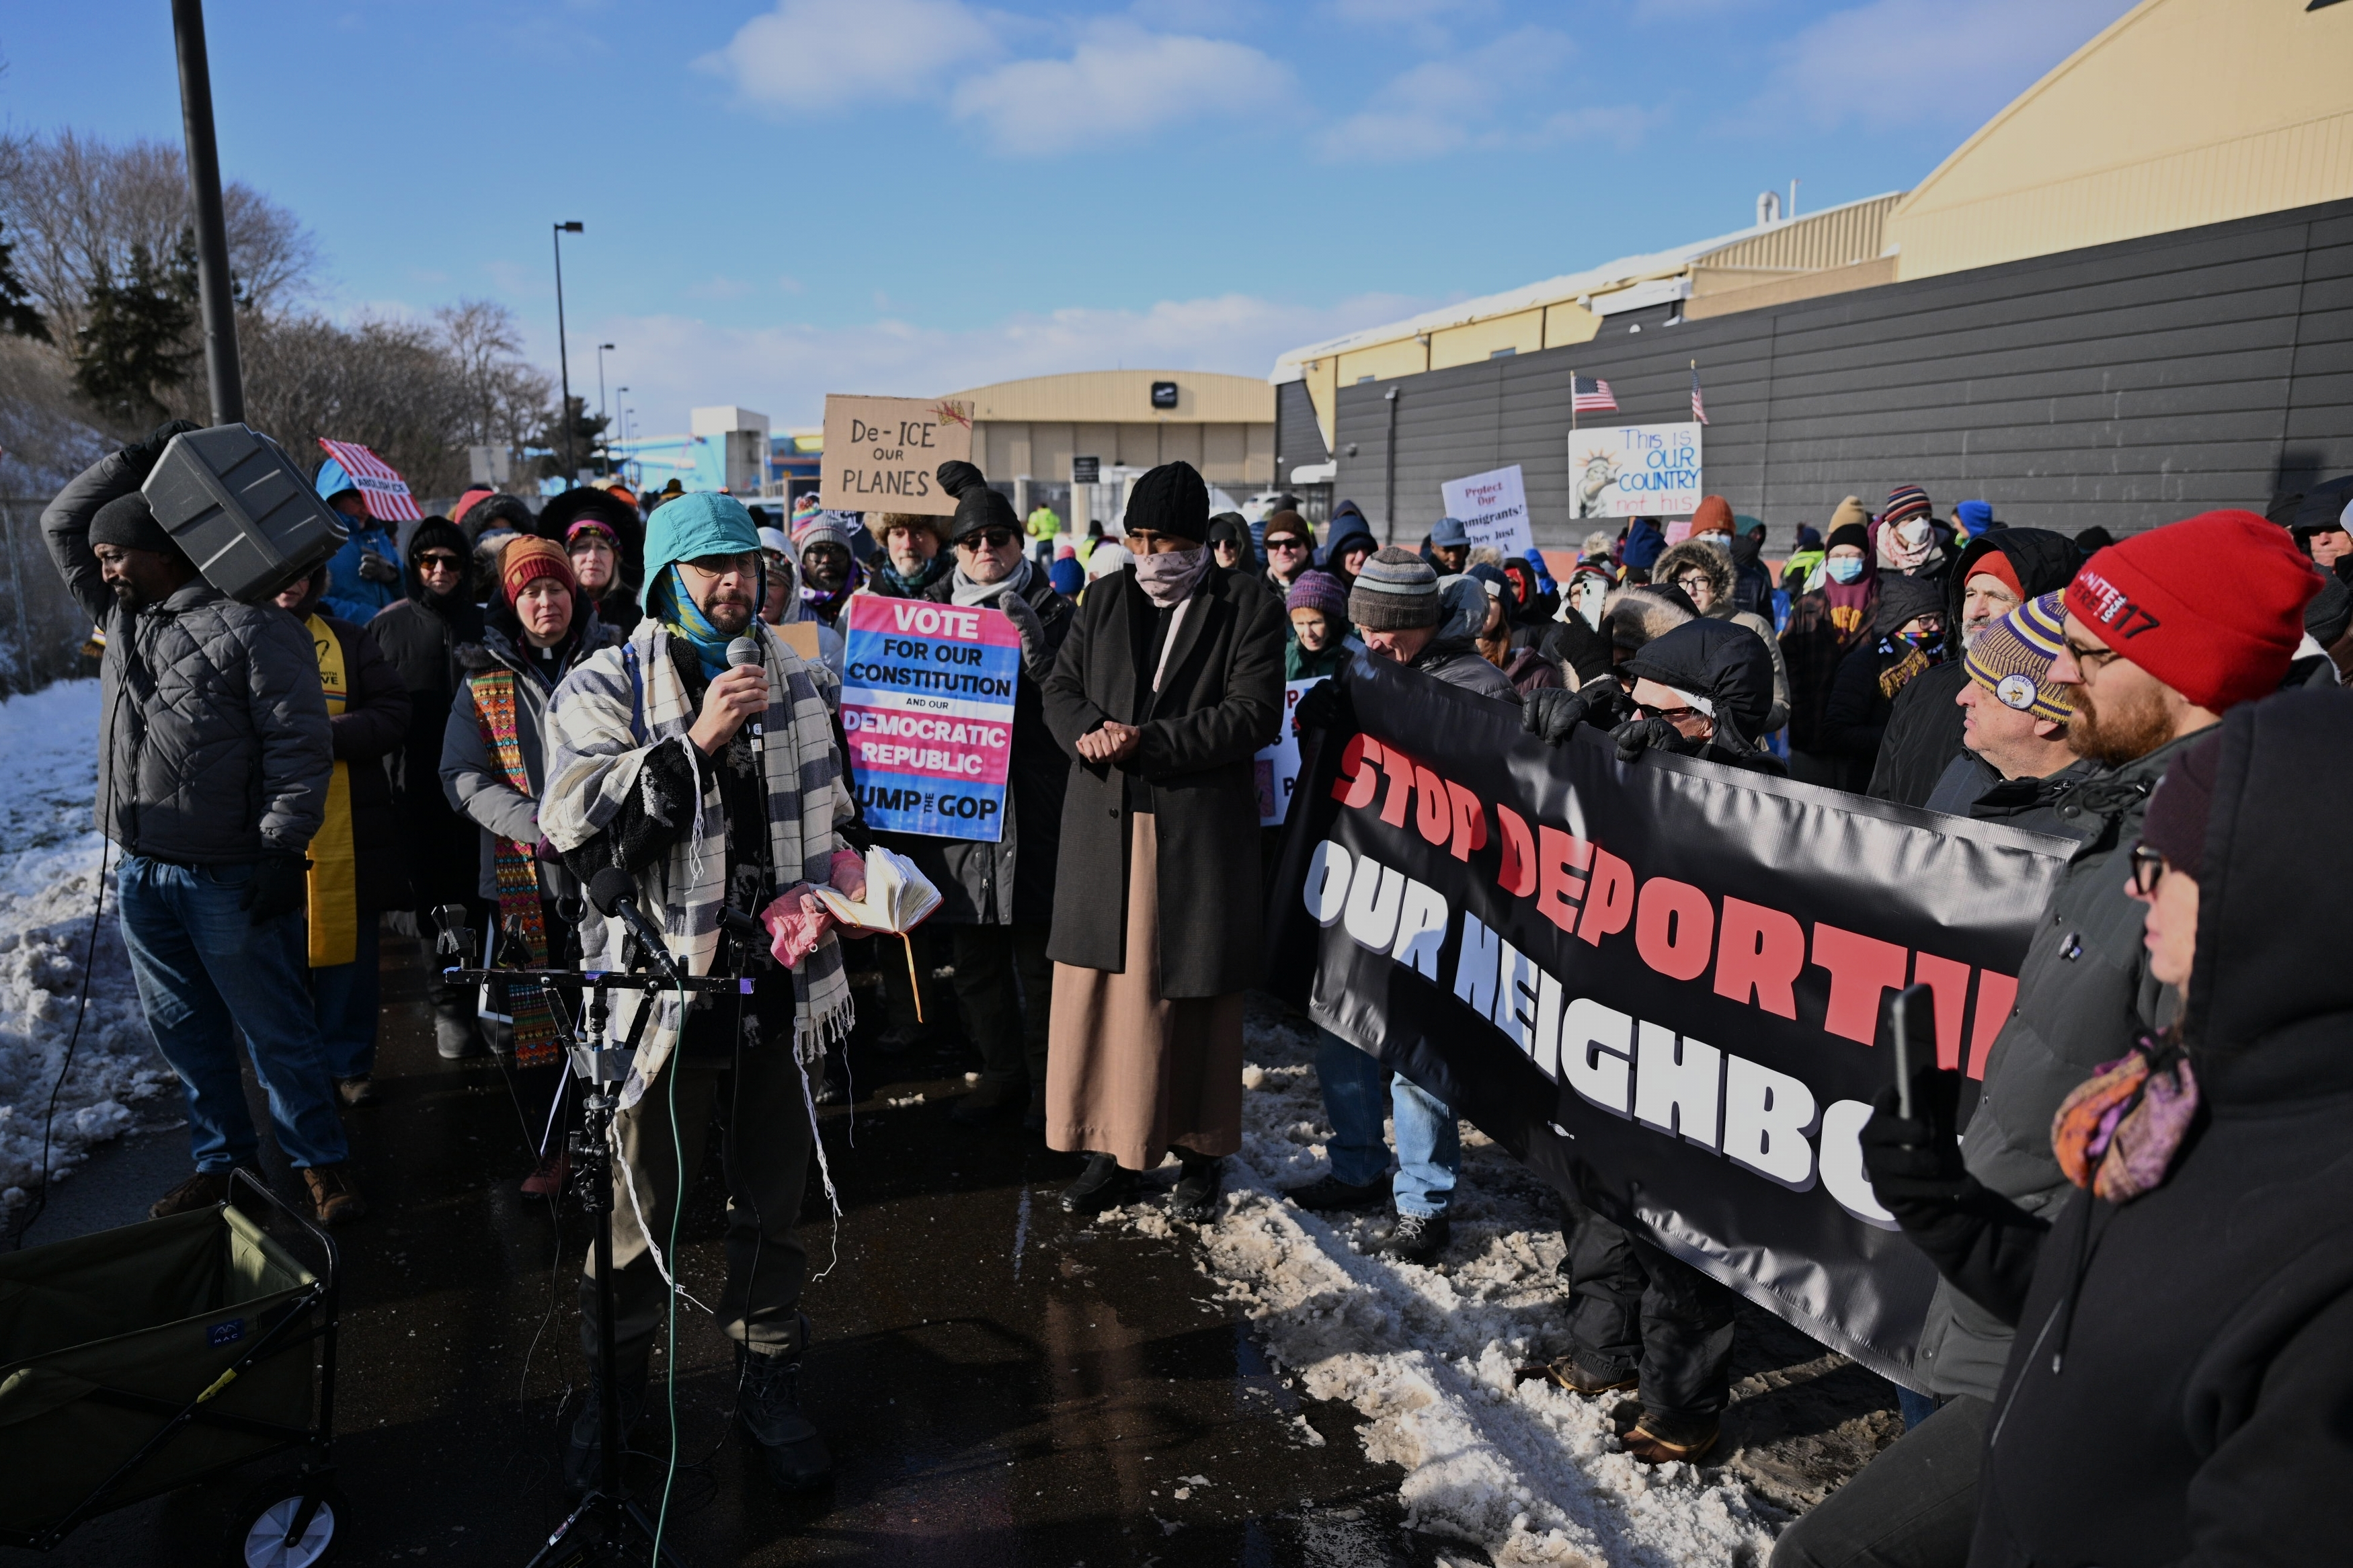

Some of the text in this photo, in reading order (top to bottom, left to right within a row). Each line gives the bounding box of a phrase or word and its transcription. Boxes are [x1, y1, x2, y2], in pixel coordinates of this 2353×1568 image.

[1619, 429, 1663, 449] This
[873, 448, 904, 461] OUR
[1647, 447, 1695, 468] OUR
[358, 479, 406, 493] ABOLISH ICE
[842, 469, 930, 497] PLANES
[1465, 482, 1503, 497] Protect
[1619, 467, 1702, 491] COUNTRY
[1478, 496, 1496, 506] Our
[1616, 493, 1692, 514] not his
[1471, 528, 1514, 544] hey Just
[2100, 595, 2128, 623] LOCAL
[894, 604, 980, 639] VOTE
[2114, 605, 2160, 639] 17
[883, 638, 983, 667] FOR OUR
[321, 676, 339, 685] VE
[849, 663, 1011, 697] CONSTITUTION
[2011, 675, 2031, 687] VIKINGS
[906, 698, 949, 710] AND OUR
[844, 710, 1007, 748] DEMOCRATIC
[861, 742, 983, 775] REPUBLIC
[856, 784, 998, 820] UMP THE GOP
[1330, 733, 1487, 862] STOP
[1304, 839, 1449, 983] OUR
[214, 1333, 238, 1344] MAC
